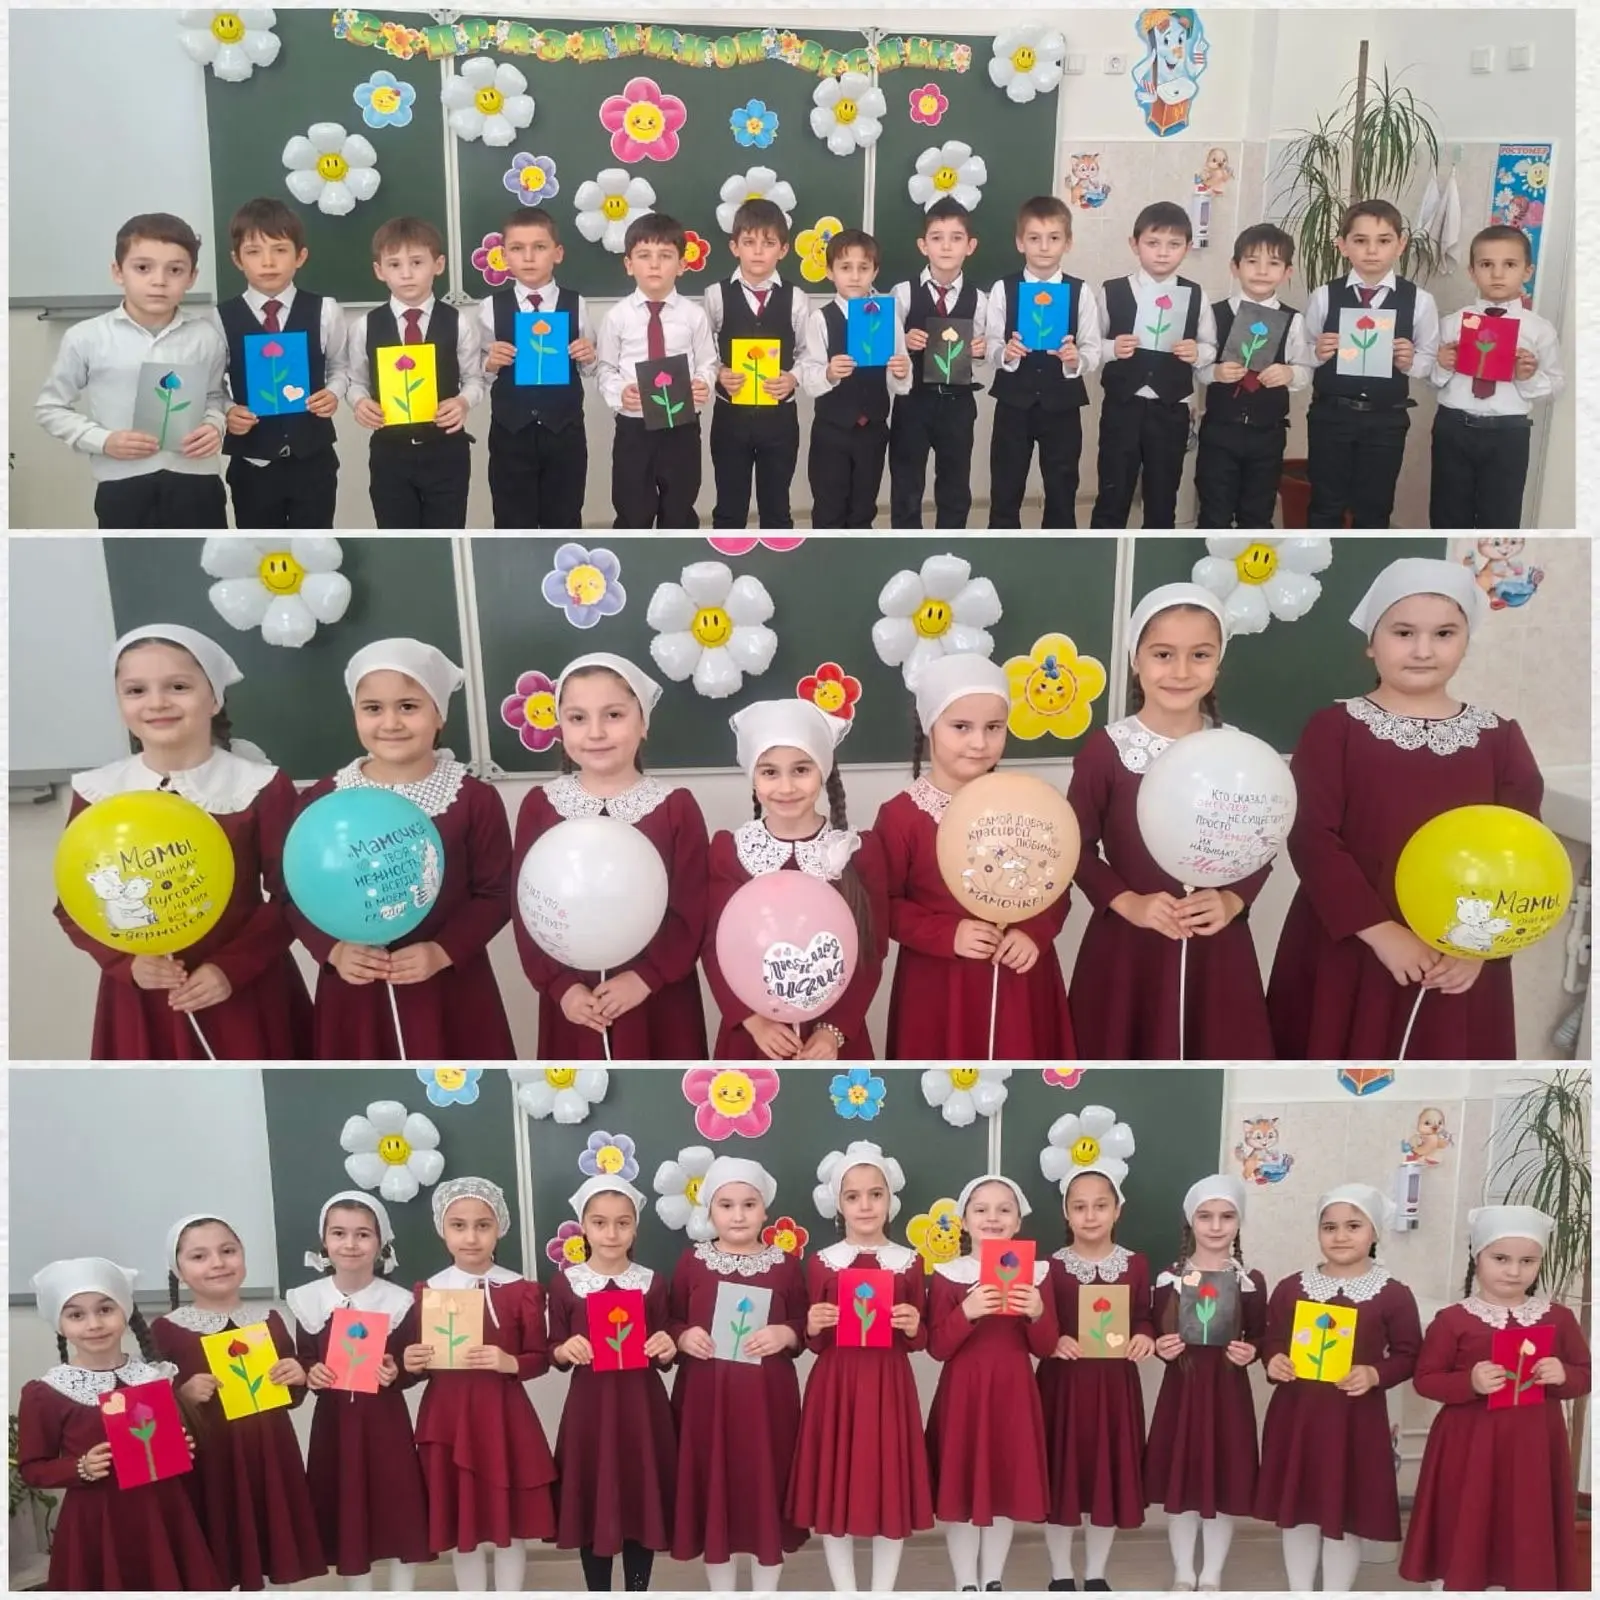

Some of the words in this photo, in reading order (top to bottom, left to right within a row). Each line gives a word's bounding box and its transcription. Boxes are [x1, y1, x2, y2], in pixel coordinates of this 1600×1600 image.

[424, 18, 766, 69] ПРАЗДНИКОМ
[796, 36, 958, 79] ВЕСНЫ
[1501, 147, 1548, 155] РОСТОМЕР
[1211, 789, 1230, 802] КТО
[977, 813, 1013, 827] САМОЙ
[1196, 814, 1232, 831] ПРОСТО
